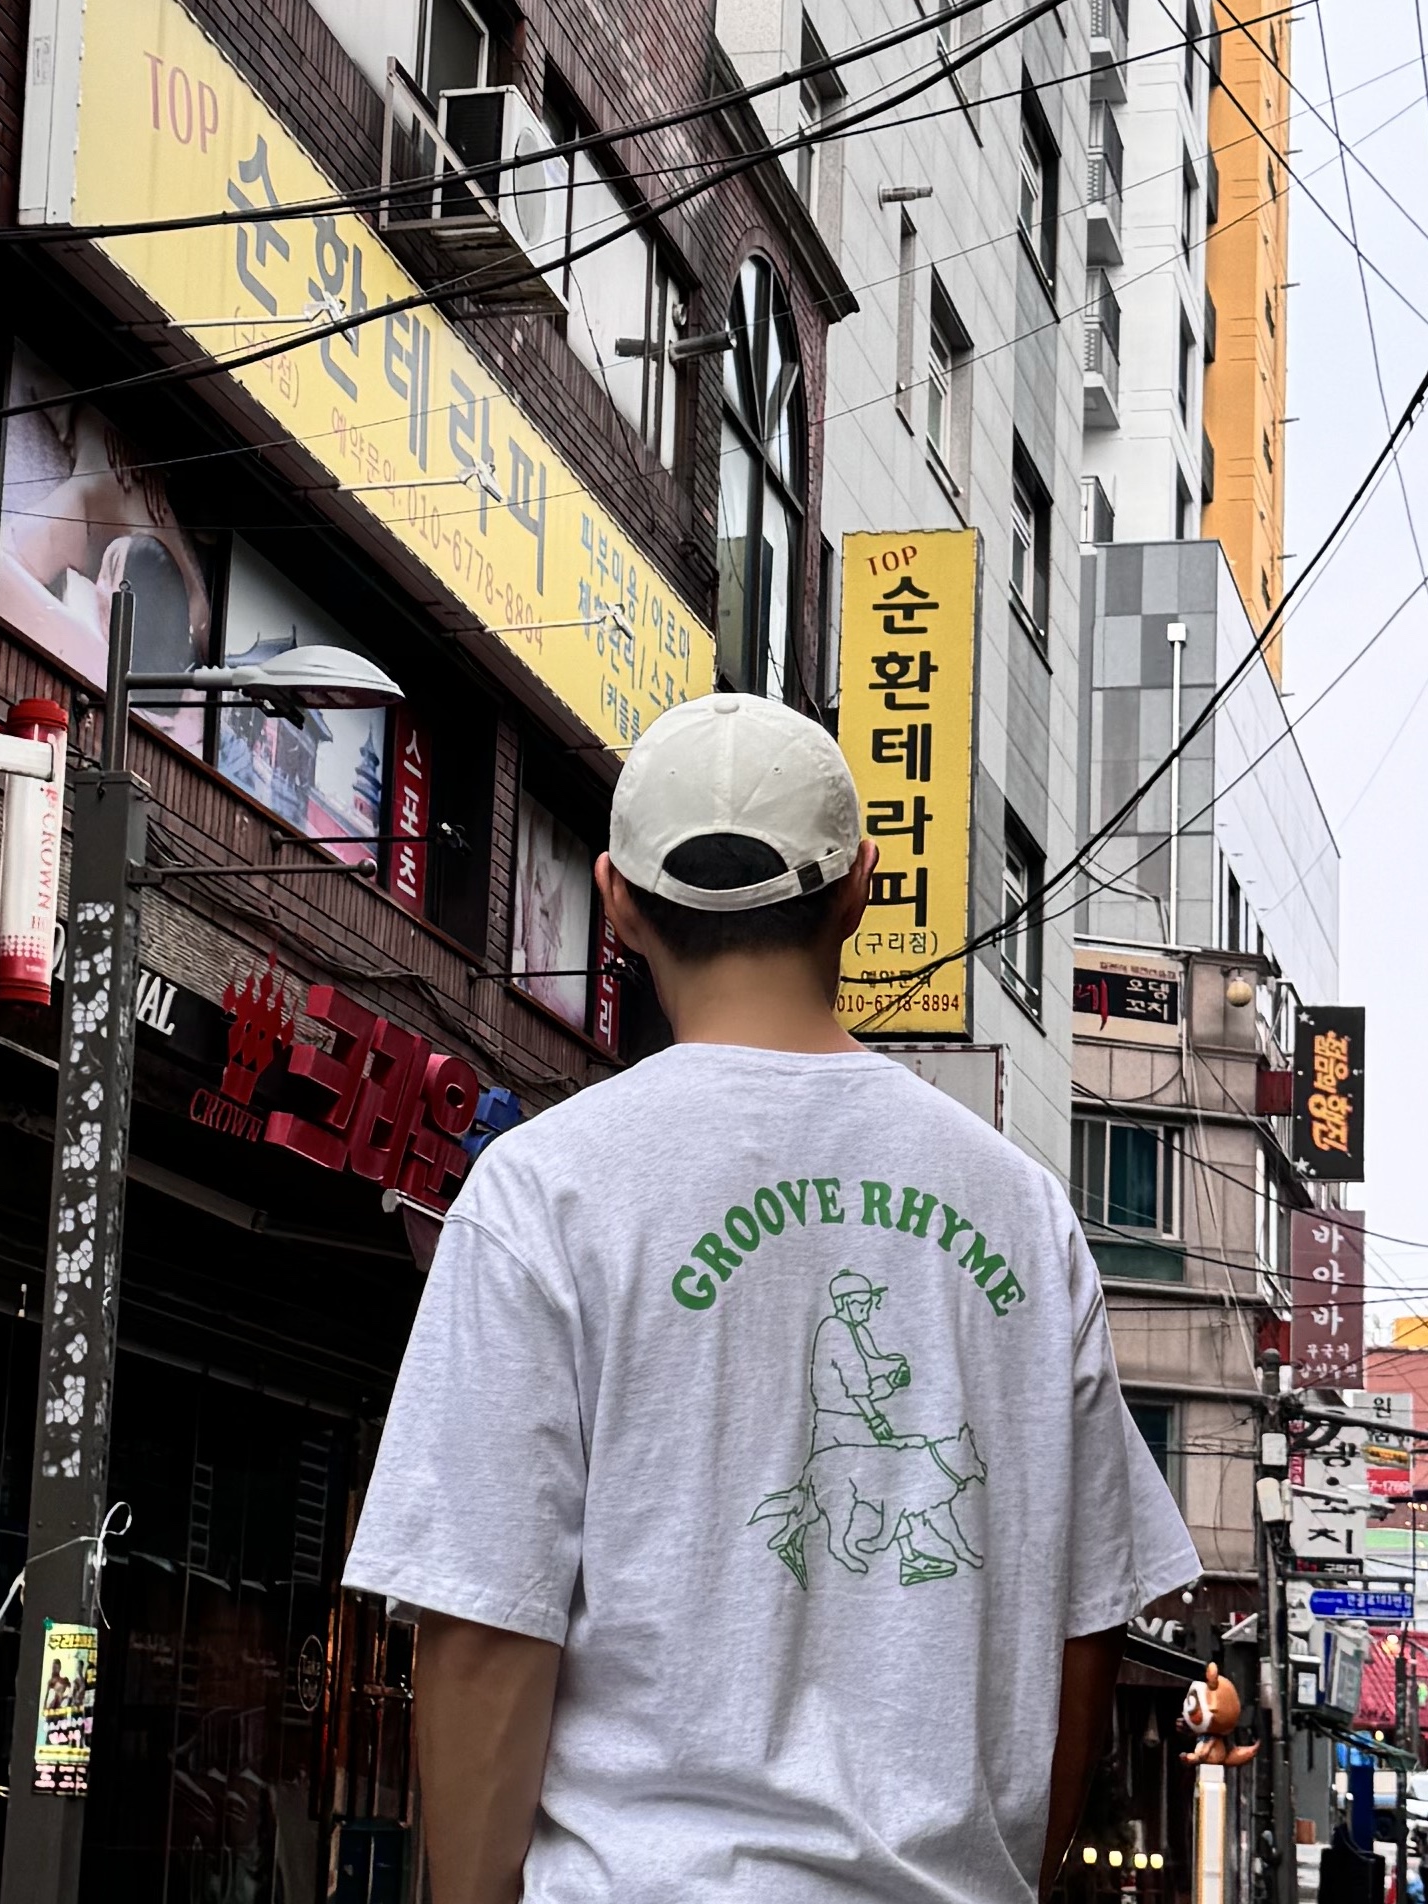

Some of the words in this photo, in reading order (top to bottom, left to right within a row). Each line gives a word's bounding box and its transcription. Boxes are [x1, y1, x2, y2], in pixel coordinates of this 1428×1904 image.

[143, 52, 219, 153] TOP
[227, 136, 546, 595] 순환테라피
[867, 546, 918, 576] TOP
[866, 576, 940, 927] 순환테라피
[854, 930, 939, 957] (구리점)
[1125, 998, 1168, 1021] 꼬치
[1126, 979, 1170, 1001] 오뎅
[190, 1088, 264, 1142] CROWN
[671, 1177, 845, 1312] GROOVE
[860, 1179, 1027, 1318] RHYME
